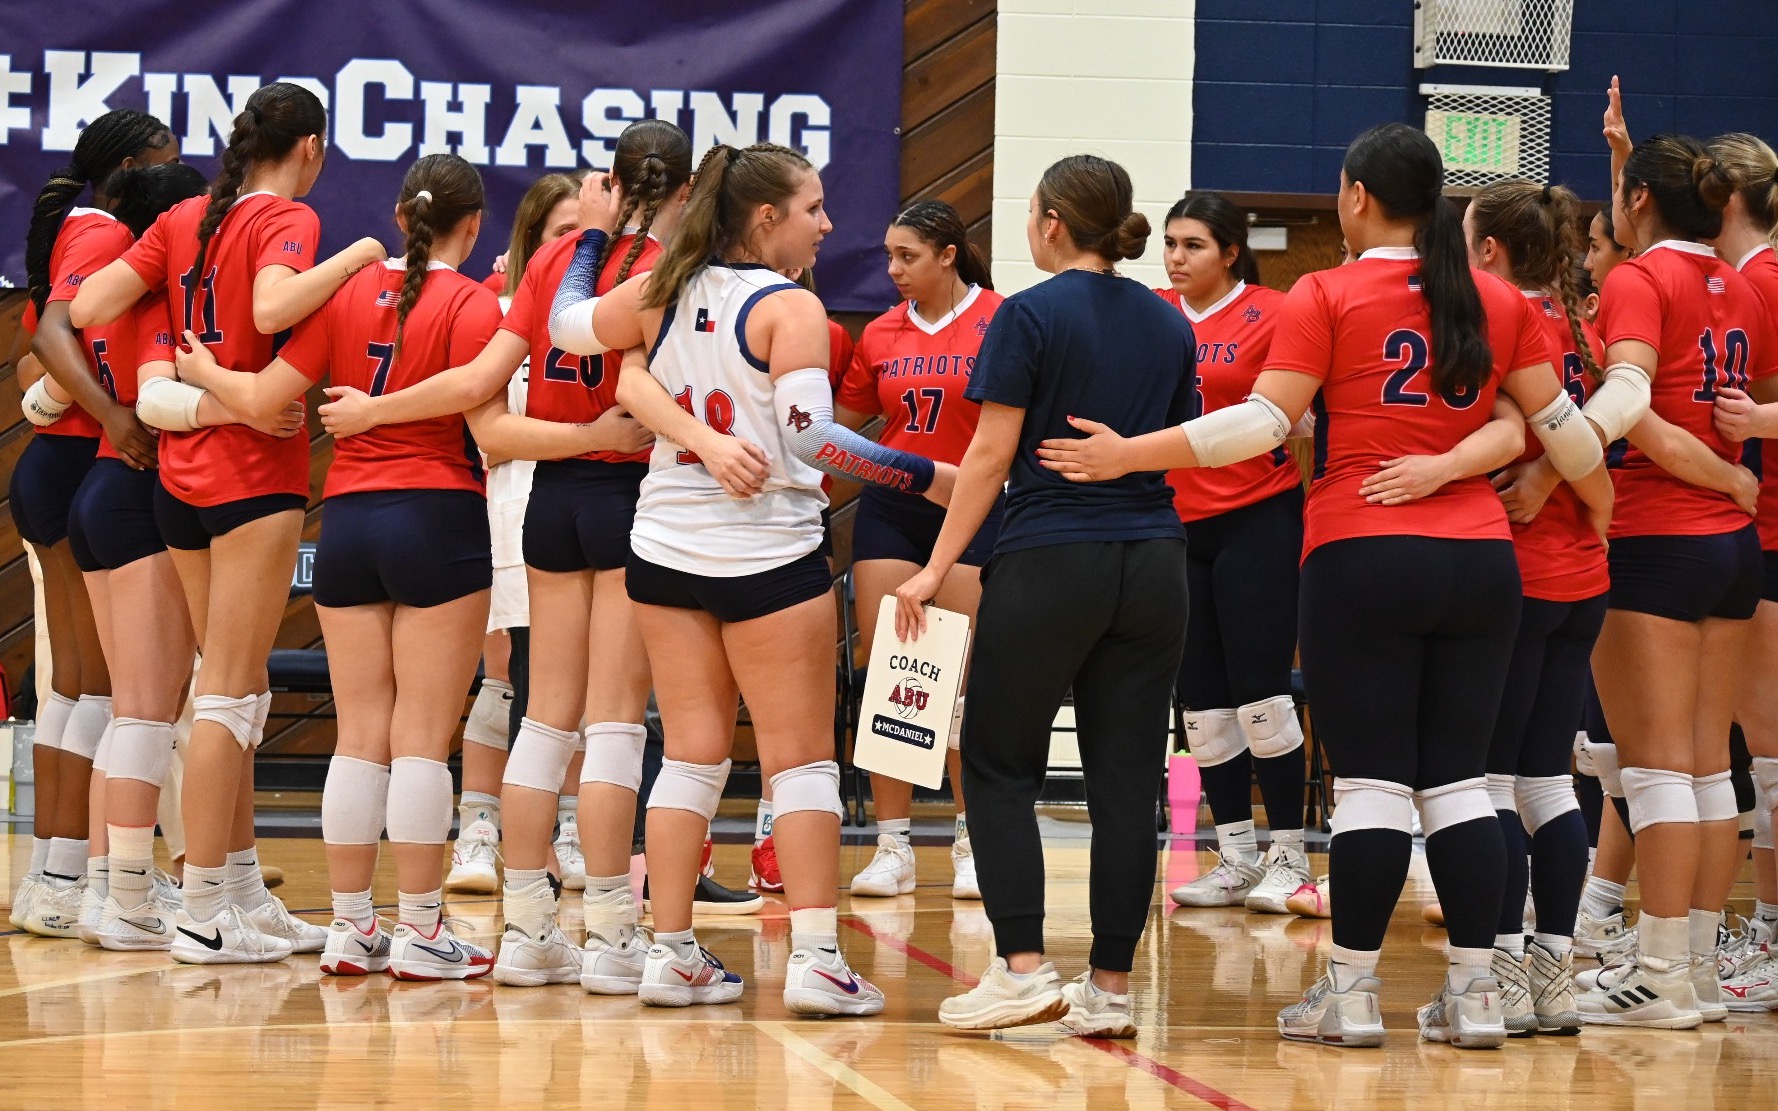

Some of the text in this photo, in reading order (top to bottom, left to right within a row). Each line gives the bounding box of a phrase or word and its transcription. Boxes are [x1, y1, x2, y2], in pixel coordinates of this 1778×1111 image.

[1444, 115, 1508, 166] EXIT
[282, 240, 303, 255] ABU
[180, 266, 224, 346] 11
[155, 332, 176, 347] ABU
[366, 341, 396, 398] 7
[881, 355, 978, 381] PATRIOTS
[1381, 328, 1481, 411] 2
[1692, 327, 1750, 403] 10
[901, 388, 945, 434] 17
[814, 441, 914, 491] PATRIOTS
[889, 655, 942, 682] COACH
[888, 684, 930, 711] ABU
[881, 721, 925, 743] MCDANIEL
